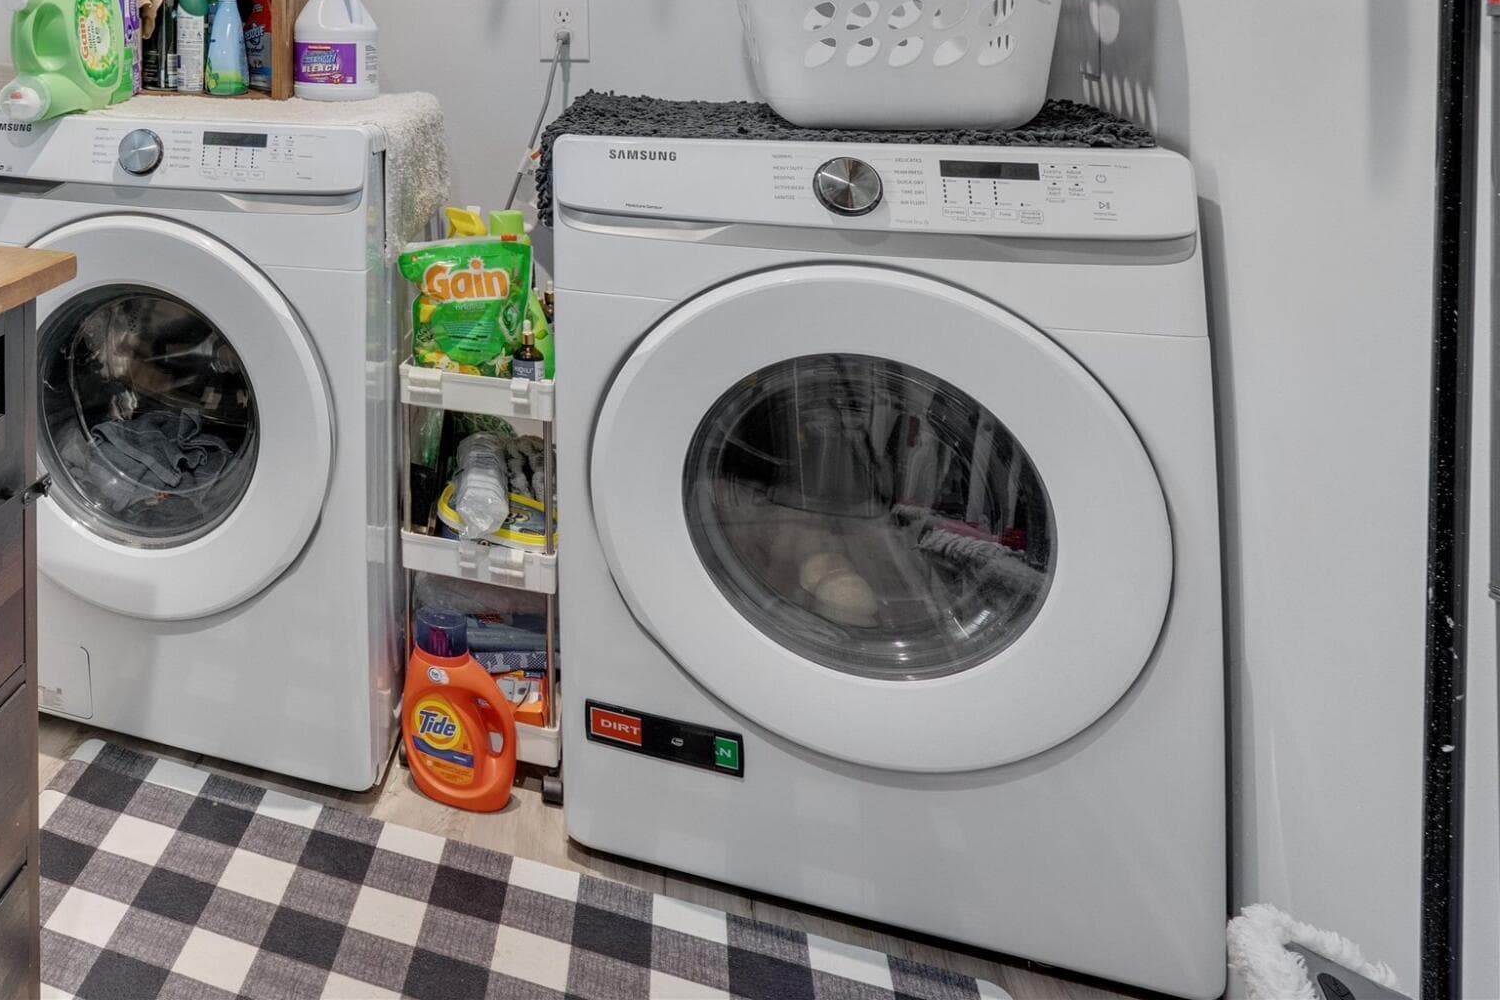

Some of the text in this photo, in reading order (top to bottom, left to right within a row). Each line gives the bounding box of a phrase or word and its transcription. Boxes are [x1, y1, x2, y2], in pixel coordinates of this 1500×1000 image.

[609, 149, 677, 161] SAMSUNG
[424, 258, 510, 302] Gain
[420, 710, 456, 737] Tide
[601, 718, 640, 736] DIRT
